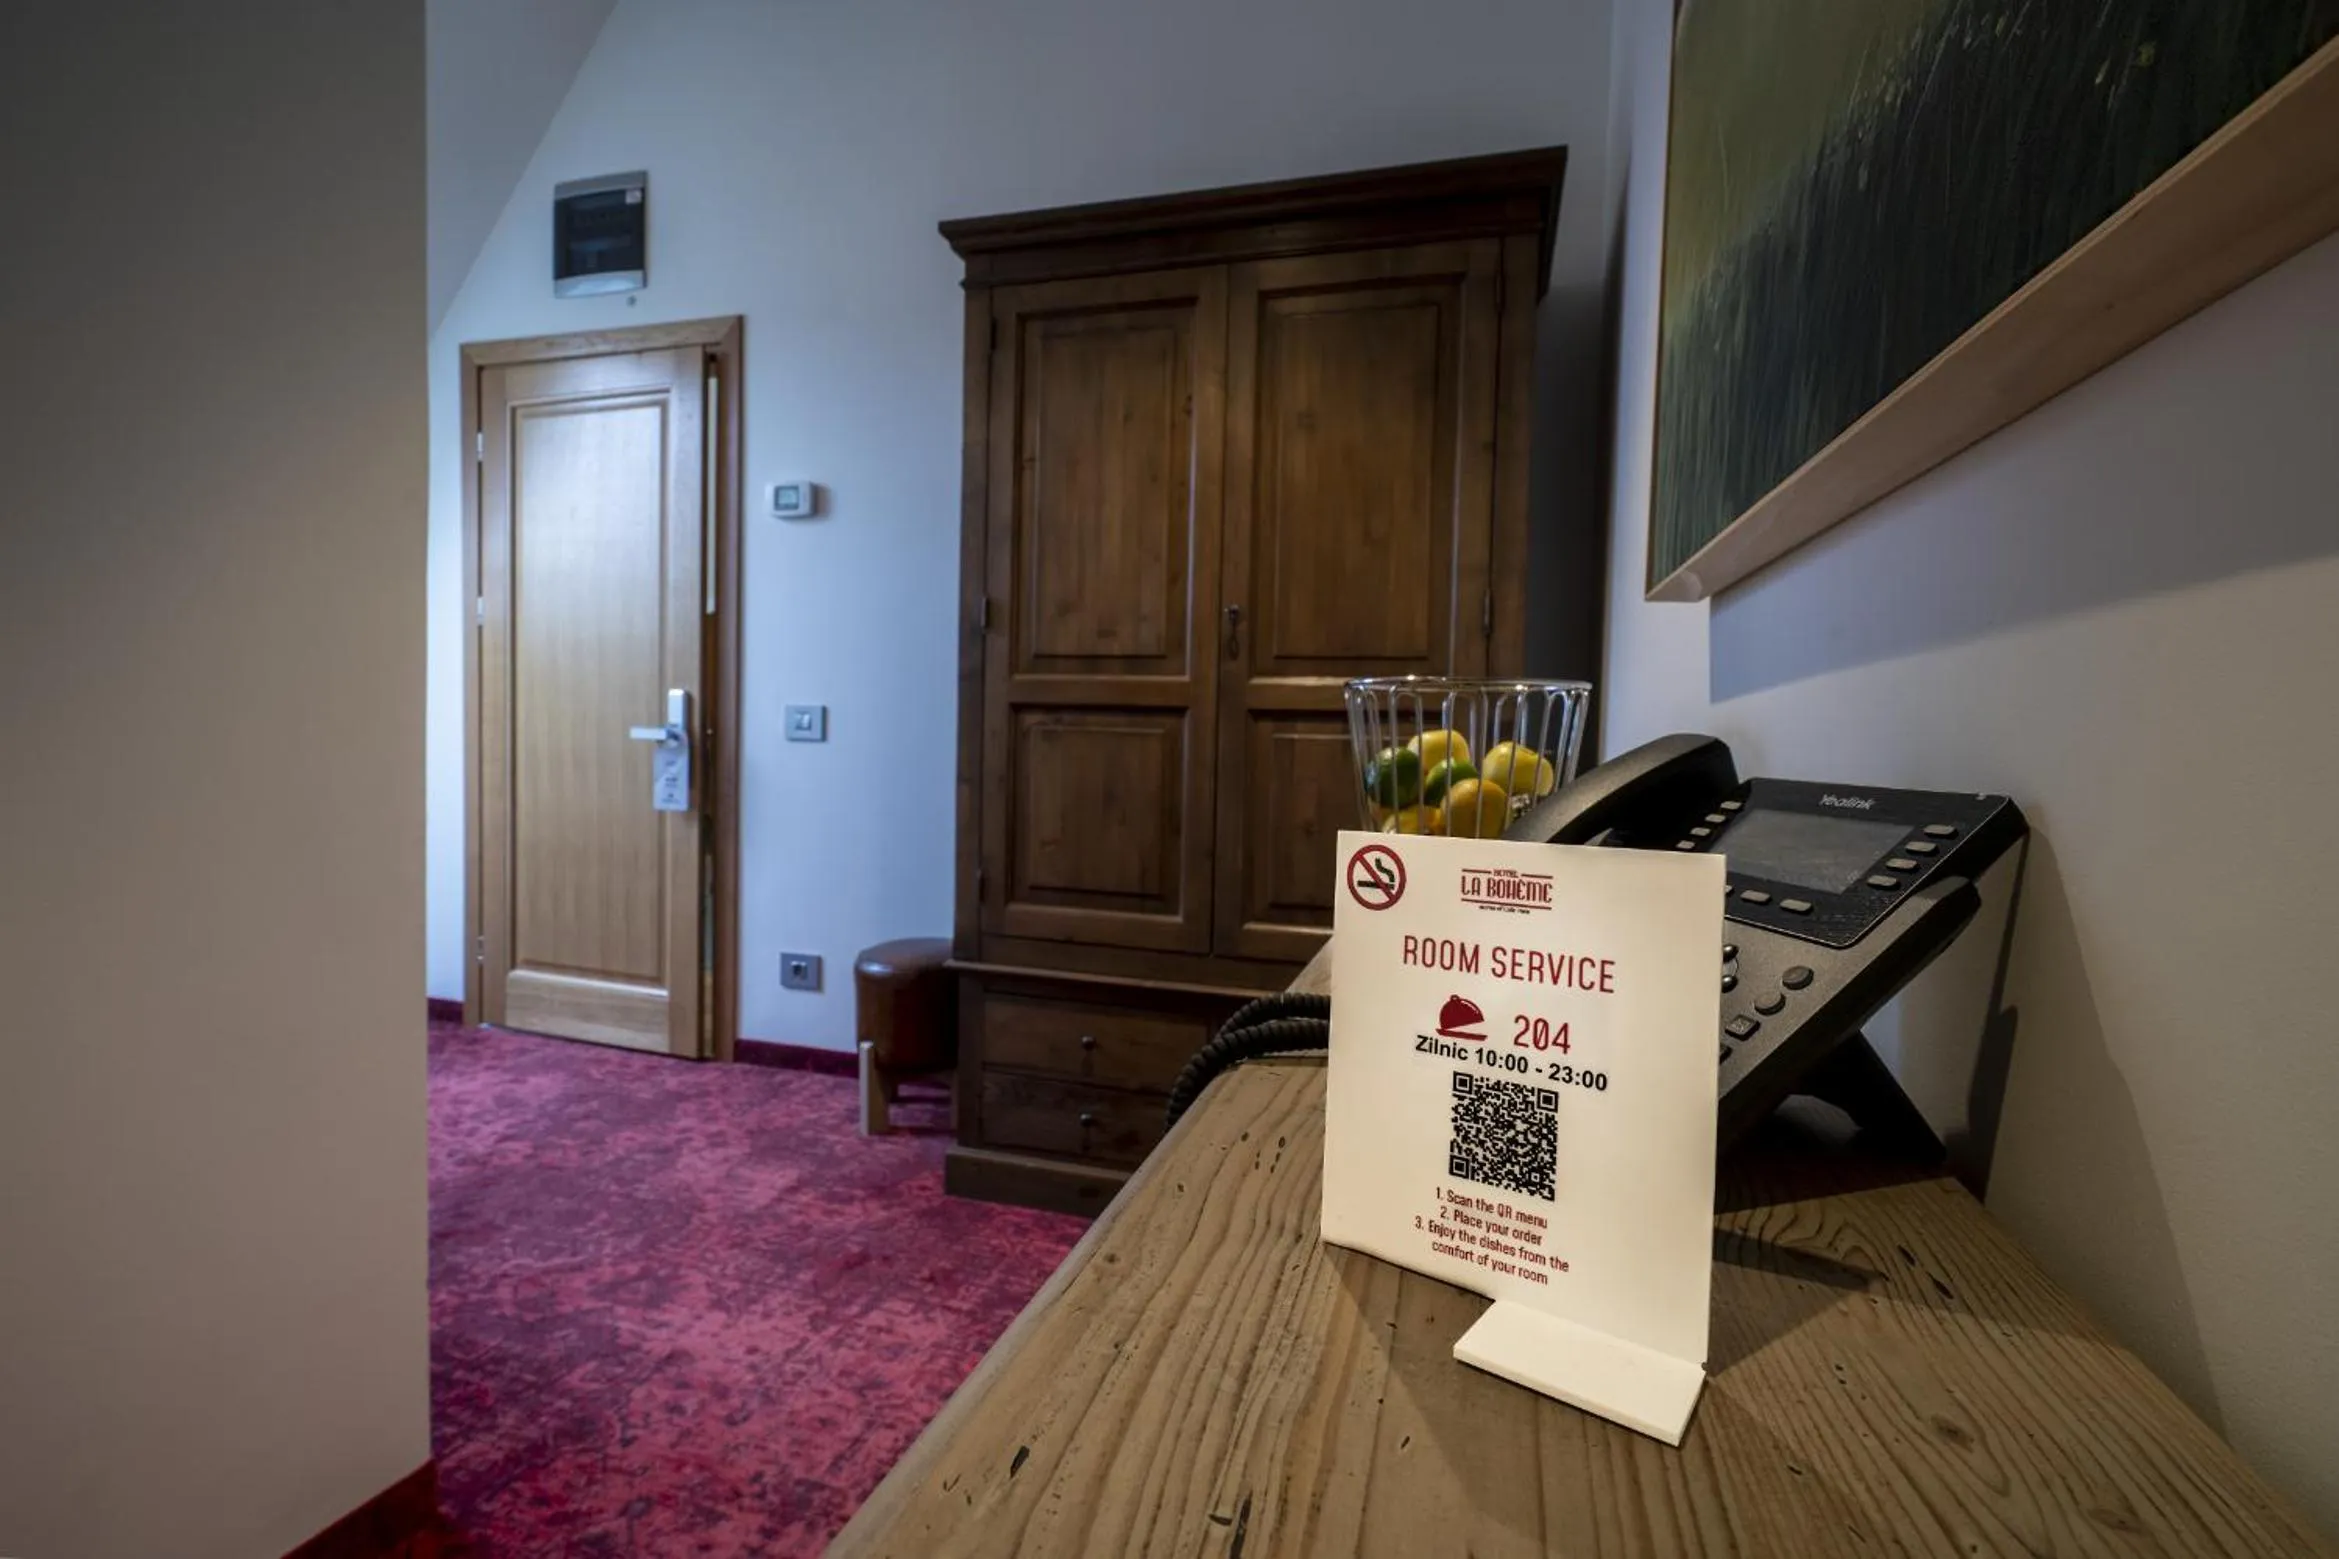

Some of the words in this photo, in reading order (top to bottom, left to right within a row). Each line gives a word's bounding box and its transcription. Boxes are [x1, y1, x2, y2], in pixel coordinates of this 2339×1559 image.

[1461, 875, 1481, 896] LA
[1403, 935, 1480, 975] ROOM
[1491, 946, 1616, 994] SERVICE
[1513, 1014, 1571, 1055] 204
[1415, 1034, 1469, 1061] Zilnic
[1475, 1047, 1529, 1074] 10:00
[1548, 1062, 1608, 1092] 23:00
[1436, 1187, 1444, 1200] 1.
[1446, 1189, 1473, 1208] Scan
[1476, 1199, 1495, 1214] the
[1497, 1203, 1512, 1220] QR
[1516, 1210, 1548, 1229] menu
[1440, 1205, 1449, 1220] 2.
[1453, 1209, 1483, 1229] Place
[1485, 1220, 1510, 1236] your
[1512, 1228, 1543, 1246] order
[1415, 1215, 1424, 1230] 3.
[1428, 1219, 1457, 1241] Enjoy
[1458, 1229, 1477, 1245] the
[1479, 1235, 1516, 1256] dishes
[1519, 1246, 1546, 1266] from
[1550, 1256, 1570, 1273] the
[1431, 1240, 1474, 1263] comfort
[1477, 1253, 1489, 1267] of
[1491, 1259, 1516, 1276] your
[1518, 1267, 1549, 1285] room
